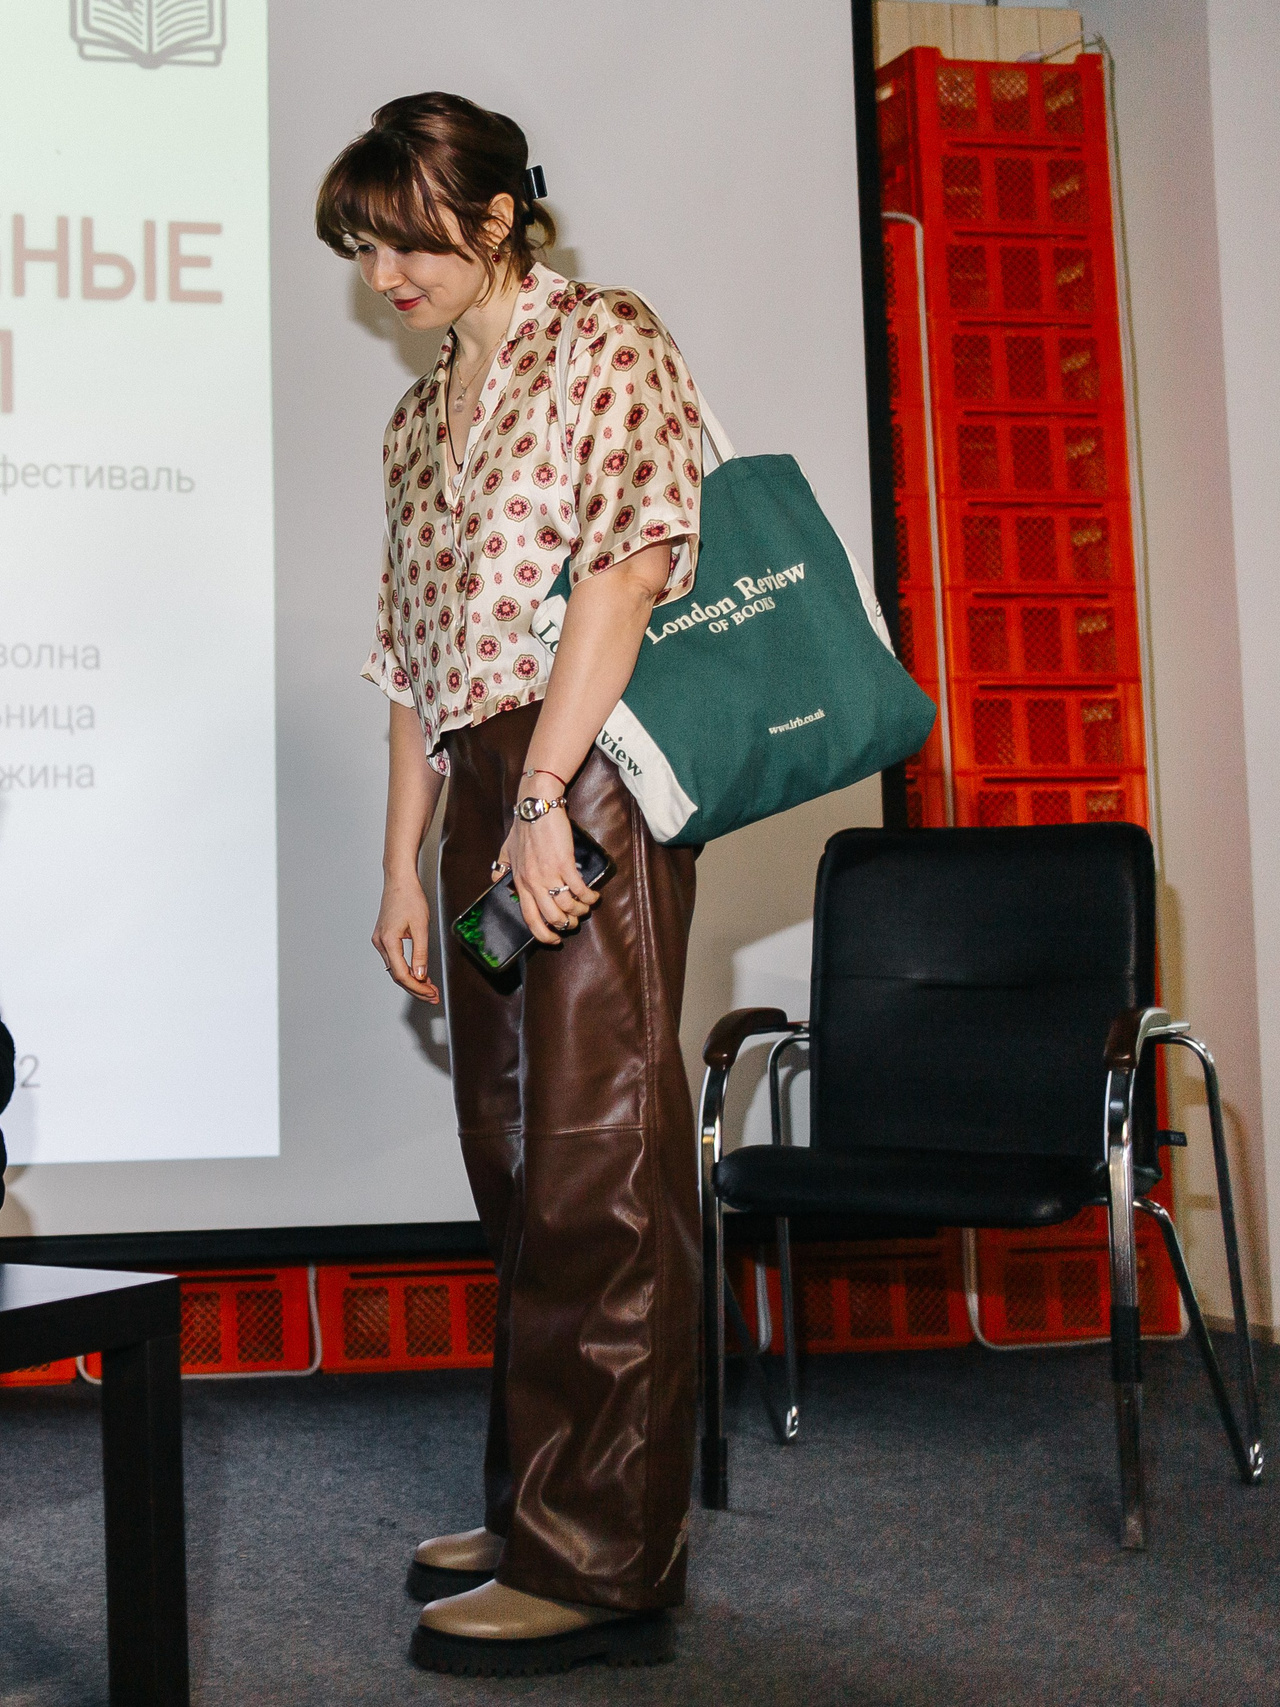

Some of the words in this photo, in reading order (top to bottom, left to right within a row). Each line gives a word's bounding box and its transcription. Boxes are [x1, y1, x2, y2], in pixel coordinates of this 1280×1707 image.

[645, 597, 738, 645] London
[733, 563, 806, 601] Review
[708, 619, 730, 634] OF
[730, 597, 776, 626] BOOKS
[601, 729, 643, 777] view
